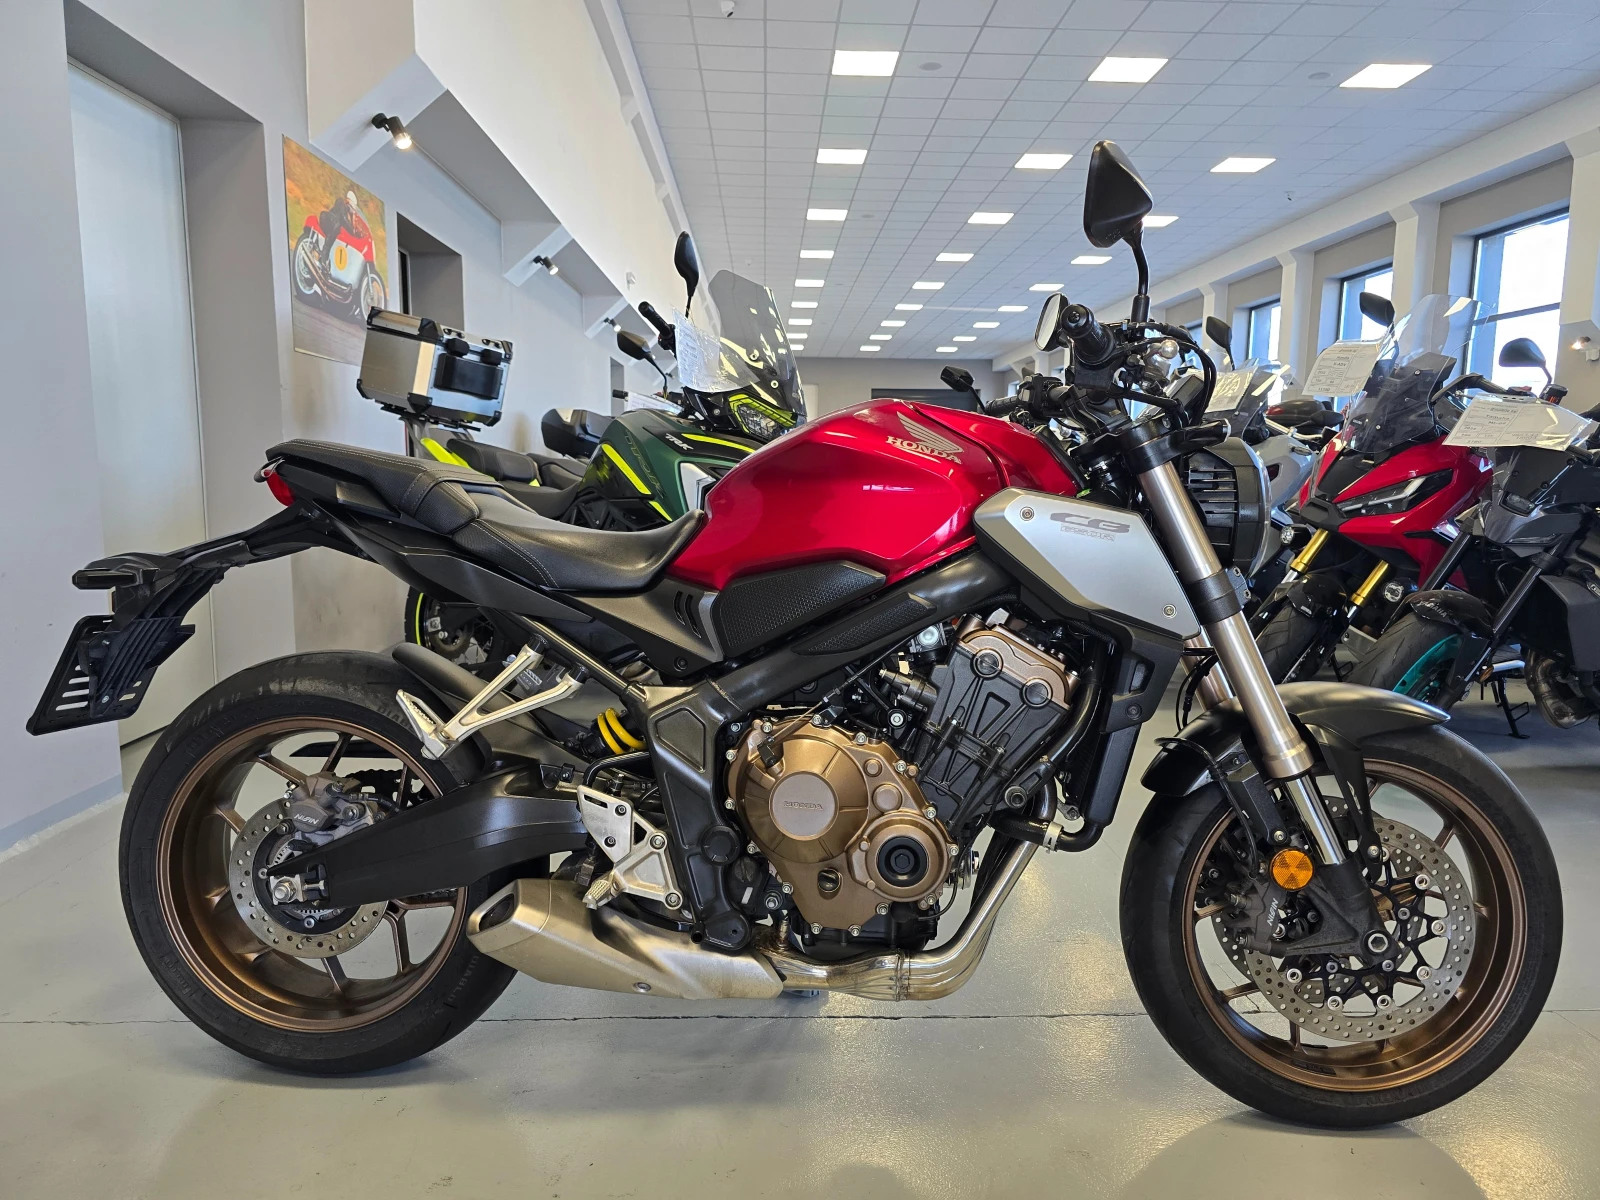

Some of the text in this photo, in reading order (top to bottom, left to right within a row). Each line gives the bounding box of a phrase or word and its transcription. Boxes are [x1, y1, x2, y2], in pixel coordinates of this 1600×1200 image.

[664, 432, 694, 451] TRK
[885, 435, 963, 465] HONDA
[1050, 512, 1131, 534] CB
[783, 800, 824, 811] HONDA
